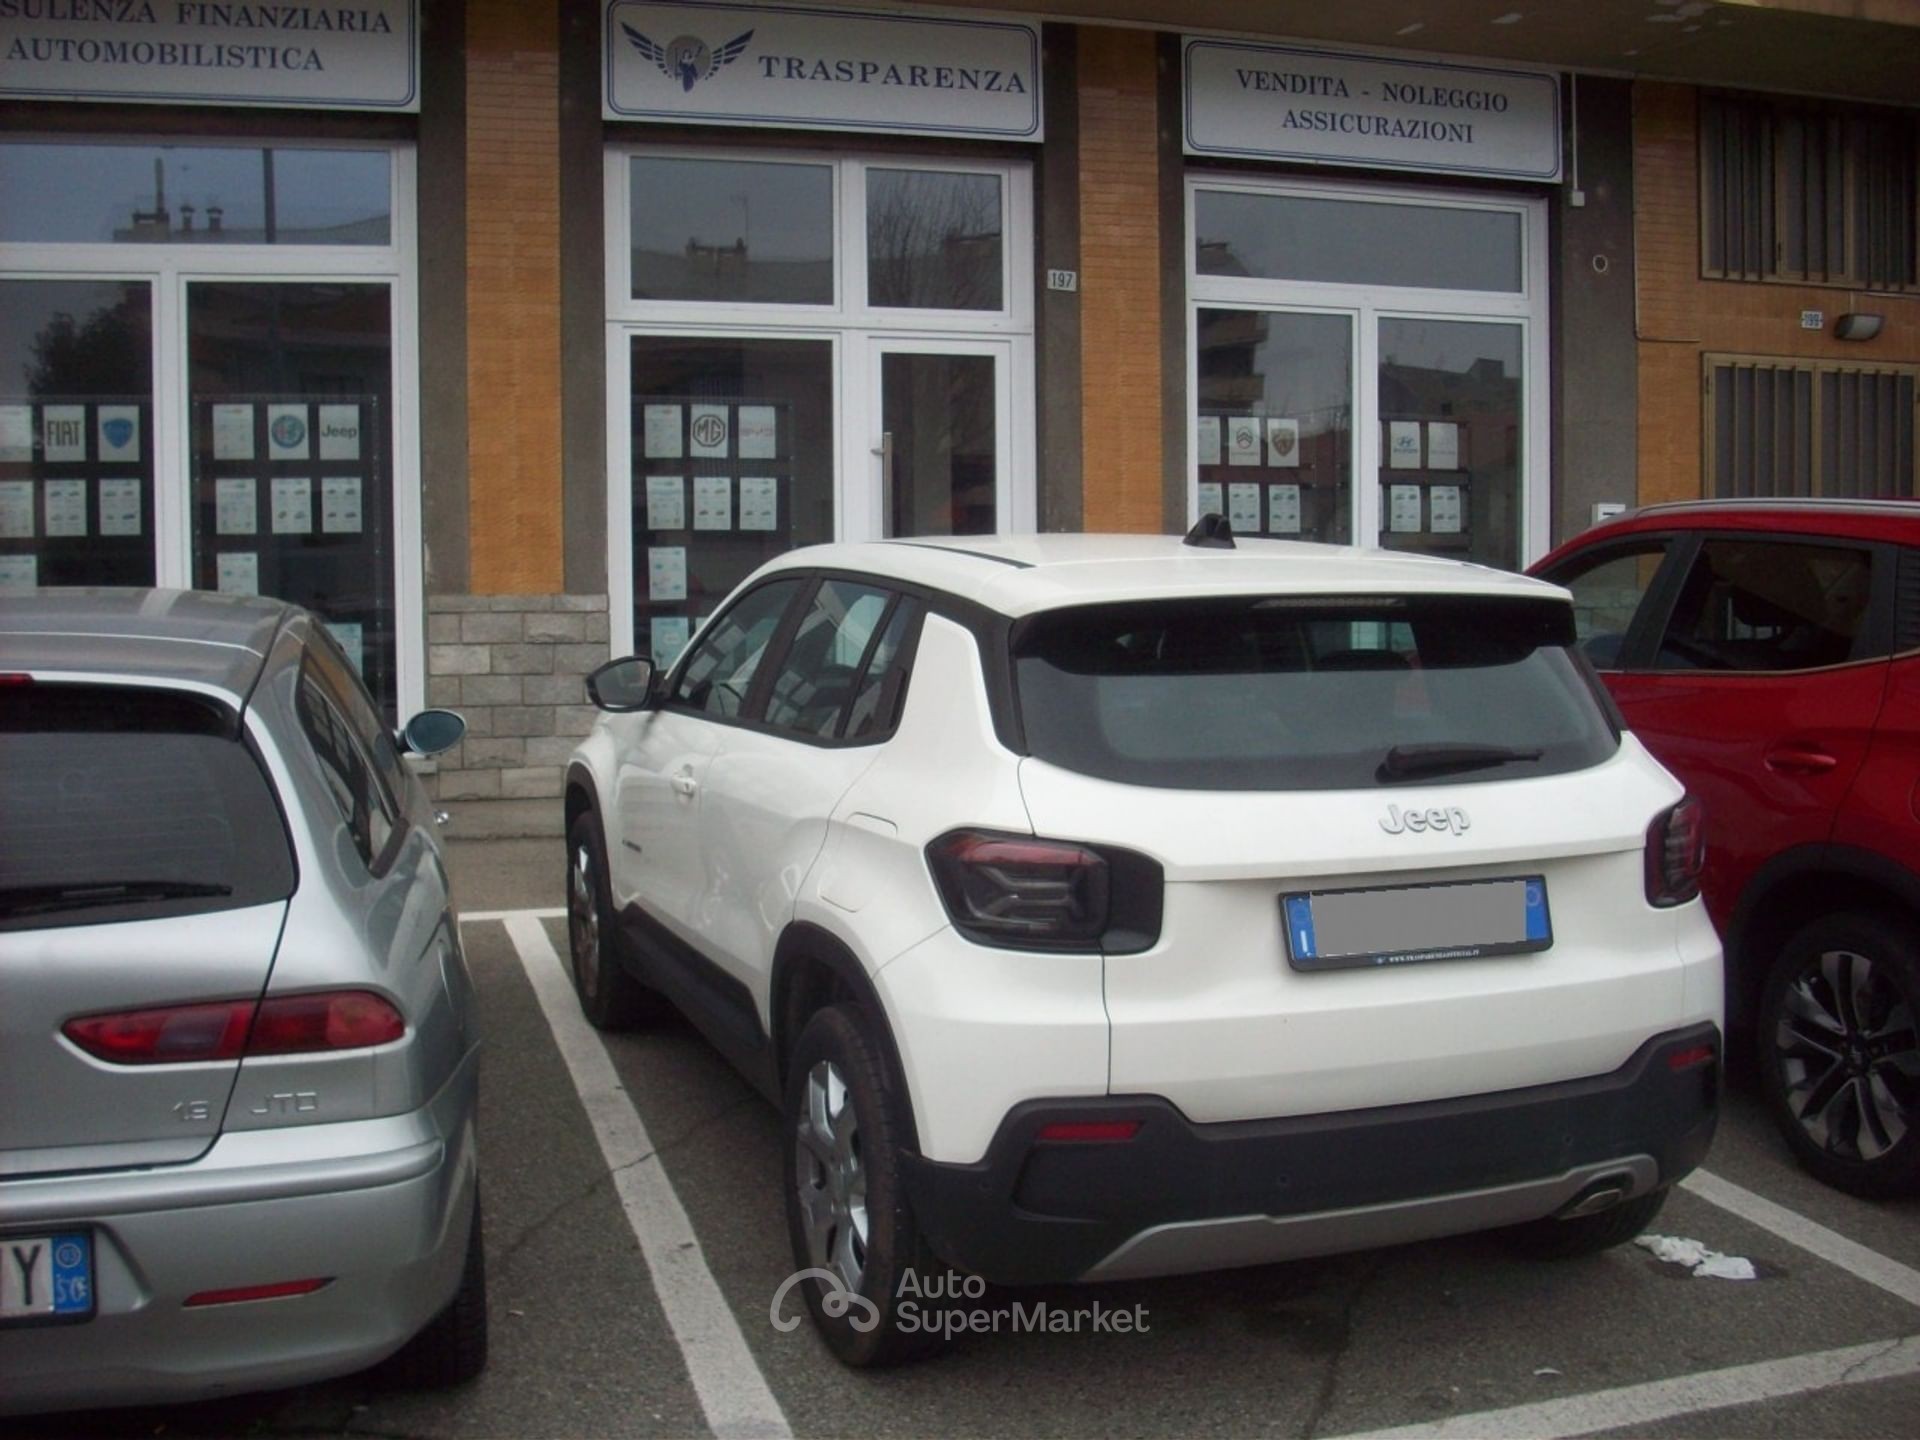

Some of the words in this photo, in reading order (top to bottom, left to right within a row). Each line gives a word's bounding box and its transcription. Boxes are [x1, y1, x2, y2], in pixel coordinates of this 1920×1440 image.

[0, 0, 156, 23] SULENZA
[177, 3, 391, 33] FINANZIARIA
[7, 37, 325, 71] AUTOMOBILISTICA
[759, 55, 1027, 94] TRASPARENZA
[1236, 69, 1349, 98] VENDITA
[1382, 81, 1509, 113] NOLEGGIO
[1281, 109, 1474, 144] ASSICURAZIONI
[1052, 271, 1073, 288] 197
[47, 419, 81, 448] FIAT
[322, 424, 358, 440] Jeep
[696, 417, 725, 444] MG
[1378, 803, 1471, 836] Jeep
[0, 1243, 42, 1307] Y
